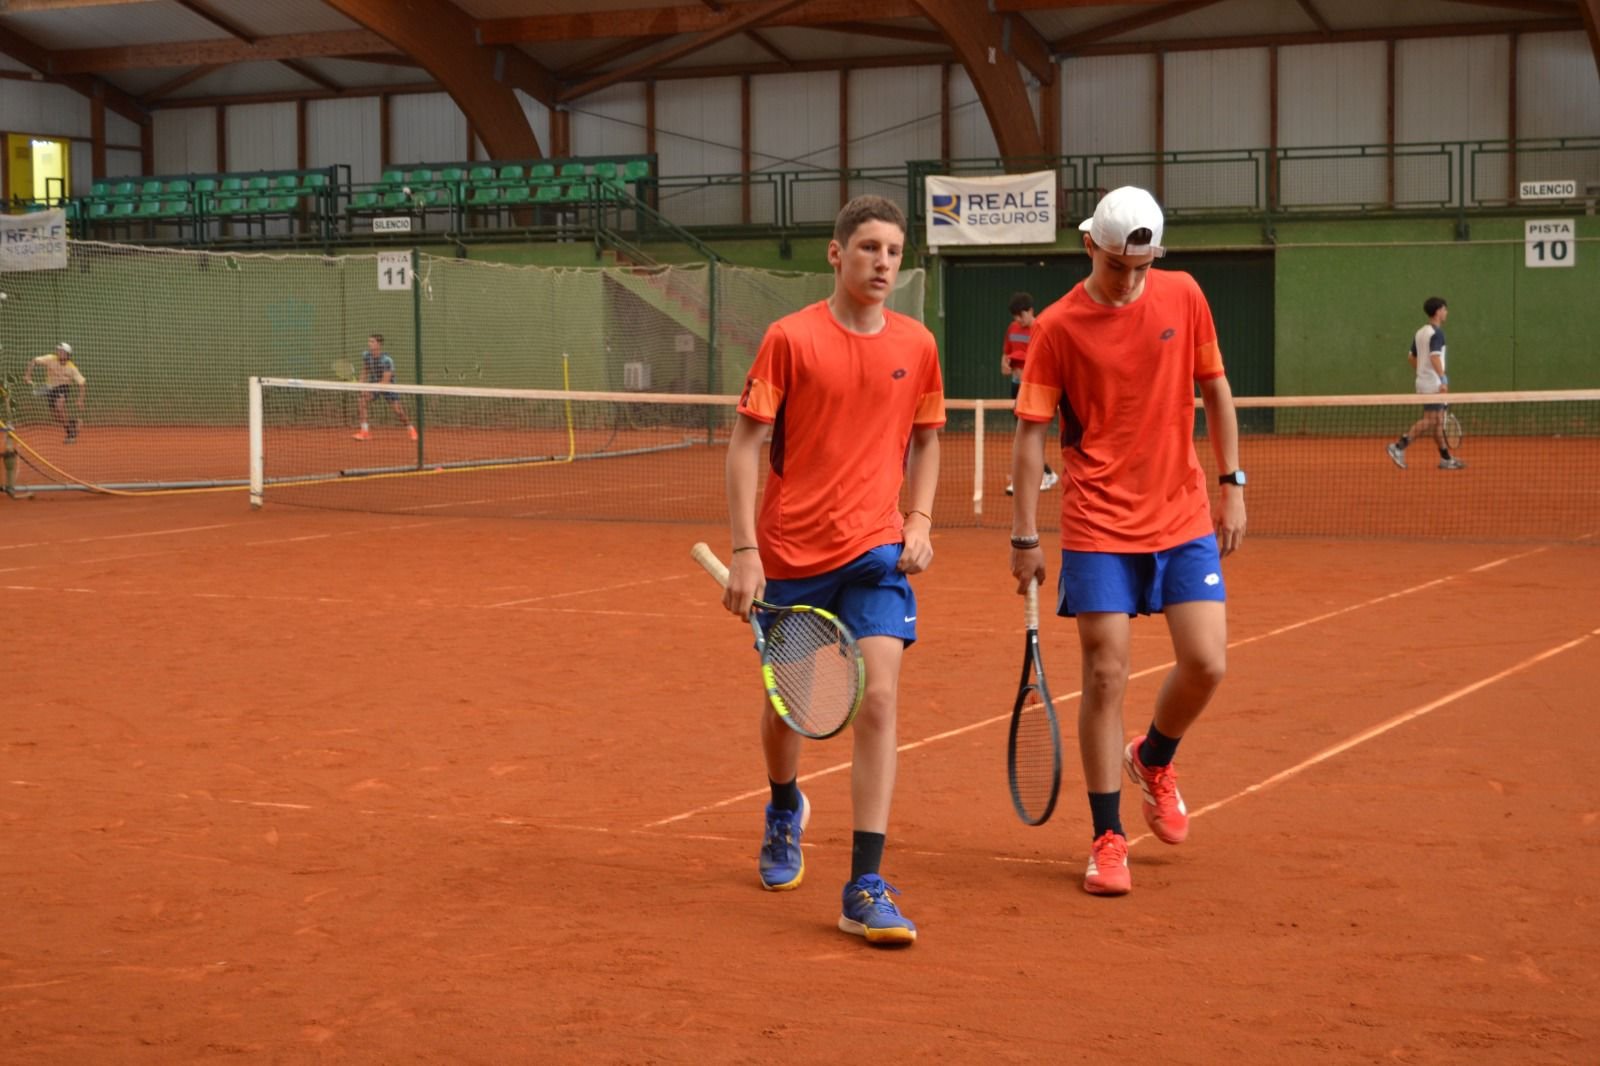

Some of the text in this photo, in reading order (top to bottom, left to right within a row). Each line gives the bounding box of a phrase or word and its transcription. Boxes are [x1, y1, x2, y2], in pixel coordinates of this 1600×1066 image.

[1522, 183, 1574, 196] SILENCIO
[968, 191, 1049, 211] REALE
[374, 219, 409, 230] SILENCIO
[967, 210, 1050, 225] SEGUROS
[5, 225, 62, 243] REALE
[1529, 224, 1570, 234] PISTA
[1532, 240, 1568, 261] 10
[383, 267, 405, 285] 11
